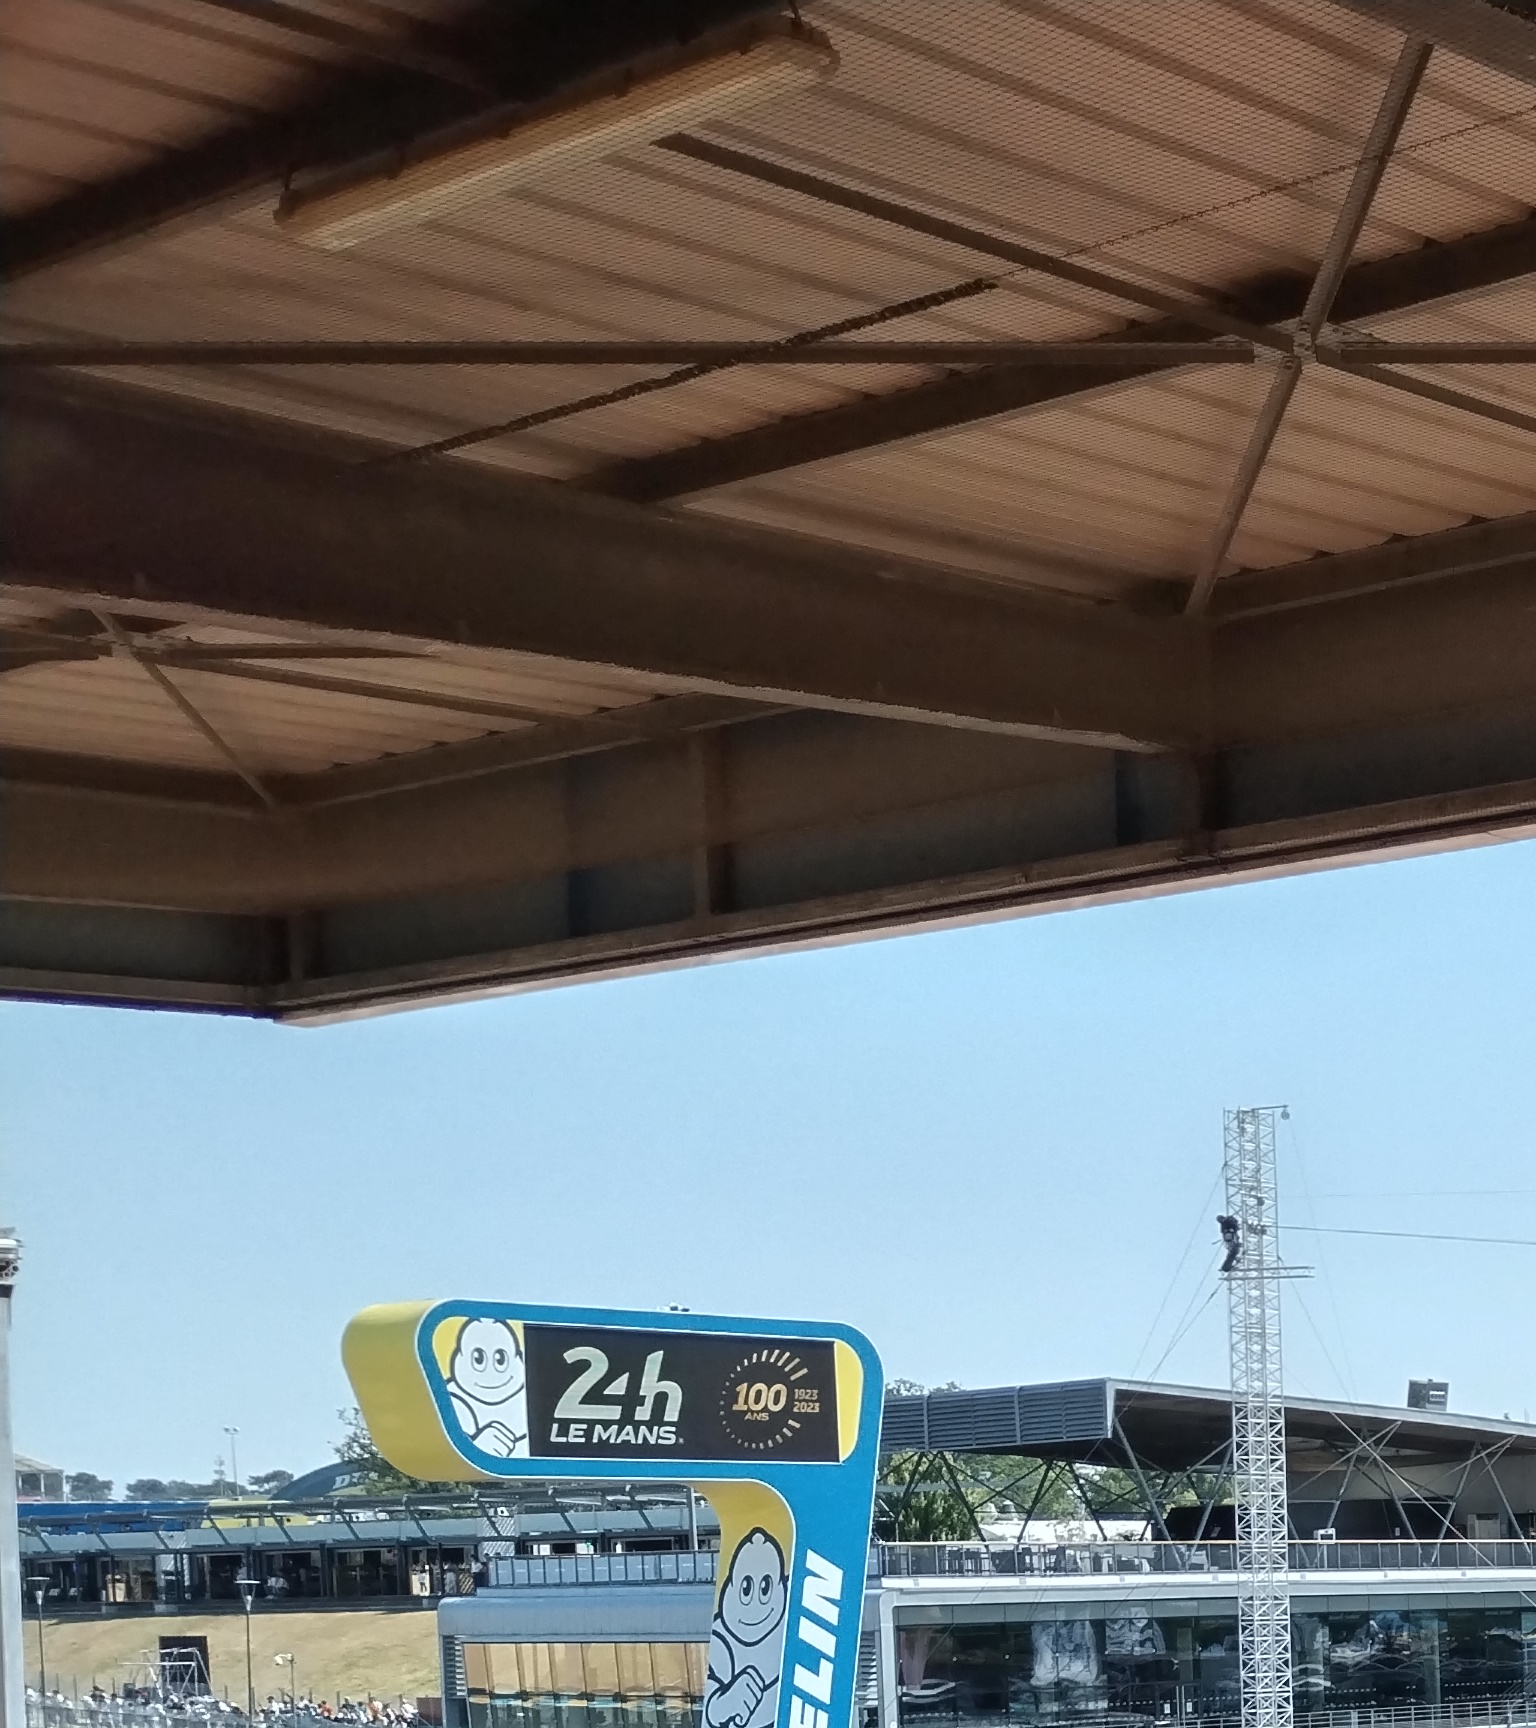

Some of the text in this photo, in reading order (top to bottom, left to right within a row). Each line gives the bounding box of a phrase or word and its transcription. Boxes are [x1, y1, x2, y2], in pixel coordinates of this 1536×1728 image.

[554, 1346, 683, 1422] 24h
[732, 1382, 818, 1411] 100 1923
[793, 1401, 819, 1413] 2023
[744, 1412, 769, 1421] ANS
[550, 1423, 677, 1445] LE MANS
